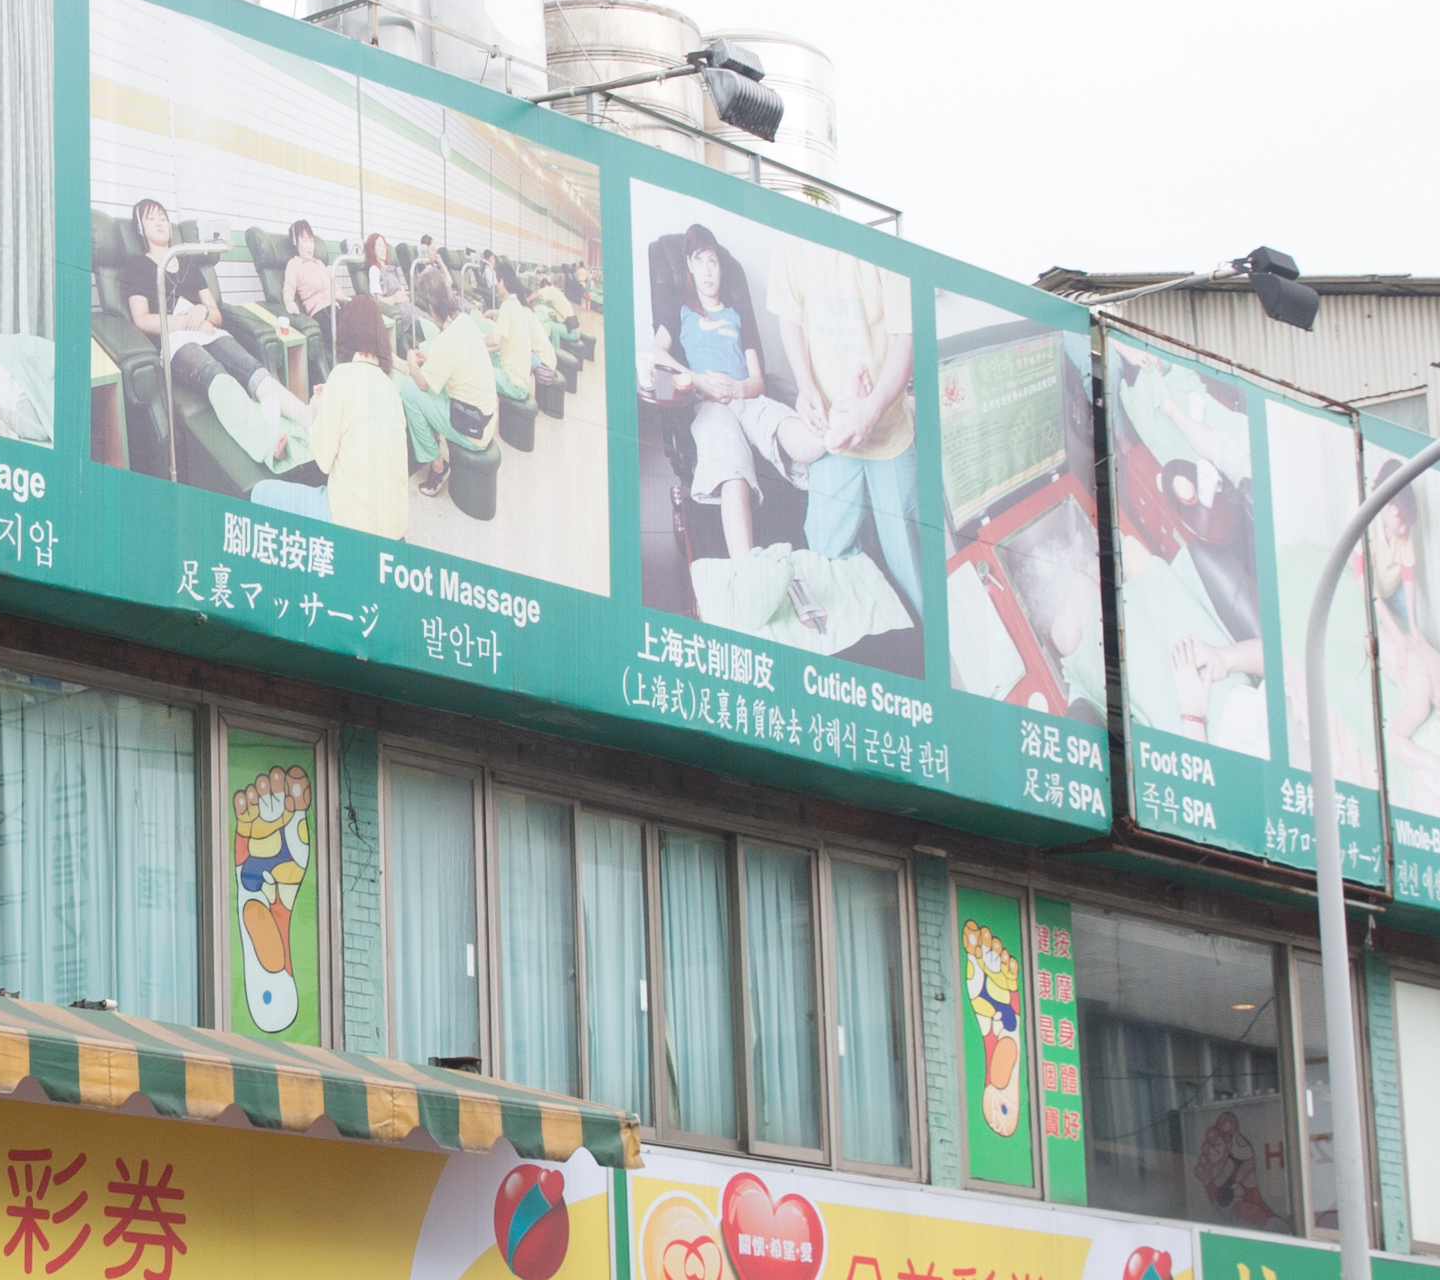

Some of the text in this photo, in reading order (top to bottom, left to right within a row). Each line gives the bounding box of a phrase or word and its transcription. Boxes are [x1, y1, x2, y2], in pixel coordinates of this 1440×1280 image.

[223, 511, 334, 579] 腳底按摩
[176, 559, 380, 639] 足裏マッサージ
[379, 552, 541, 627] Foot Massage
[421, 616, 502, 675] 발안마
[637, 621, 776, 693] 上海式削腳皮
[803, 664, 934, 728] Cuticle Scrape
[1140, 741, 1216, 787] Foot SPA
[1182, 795, 1217, 830] SPA
